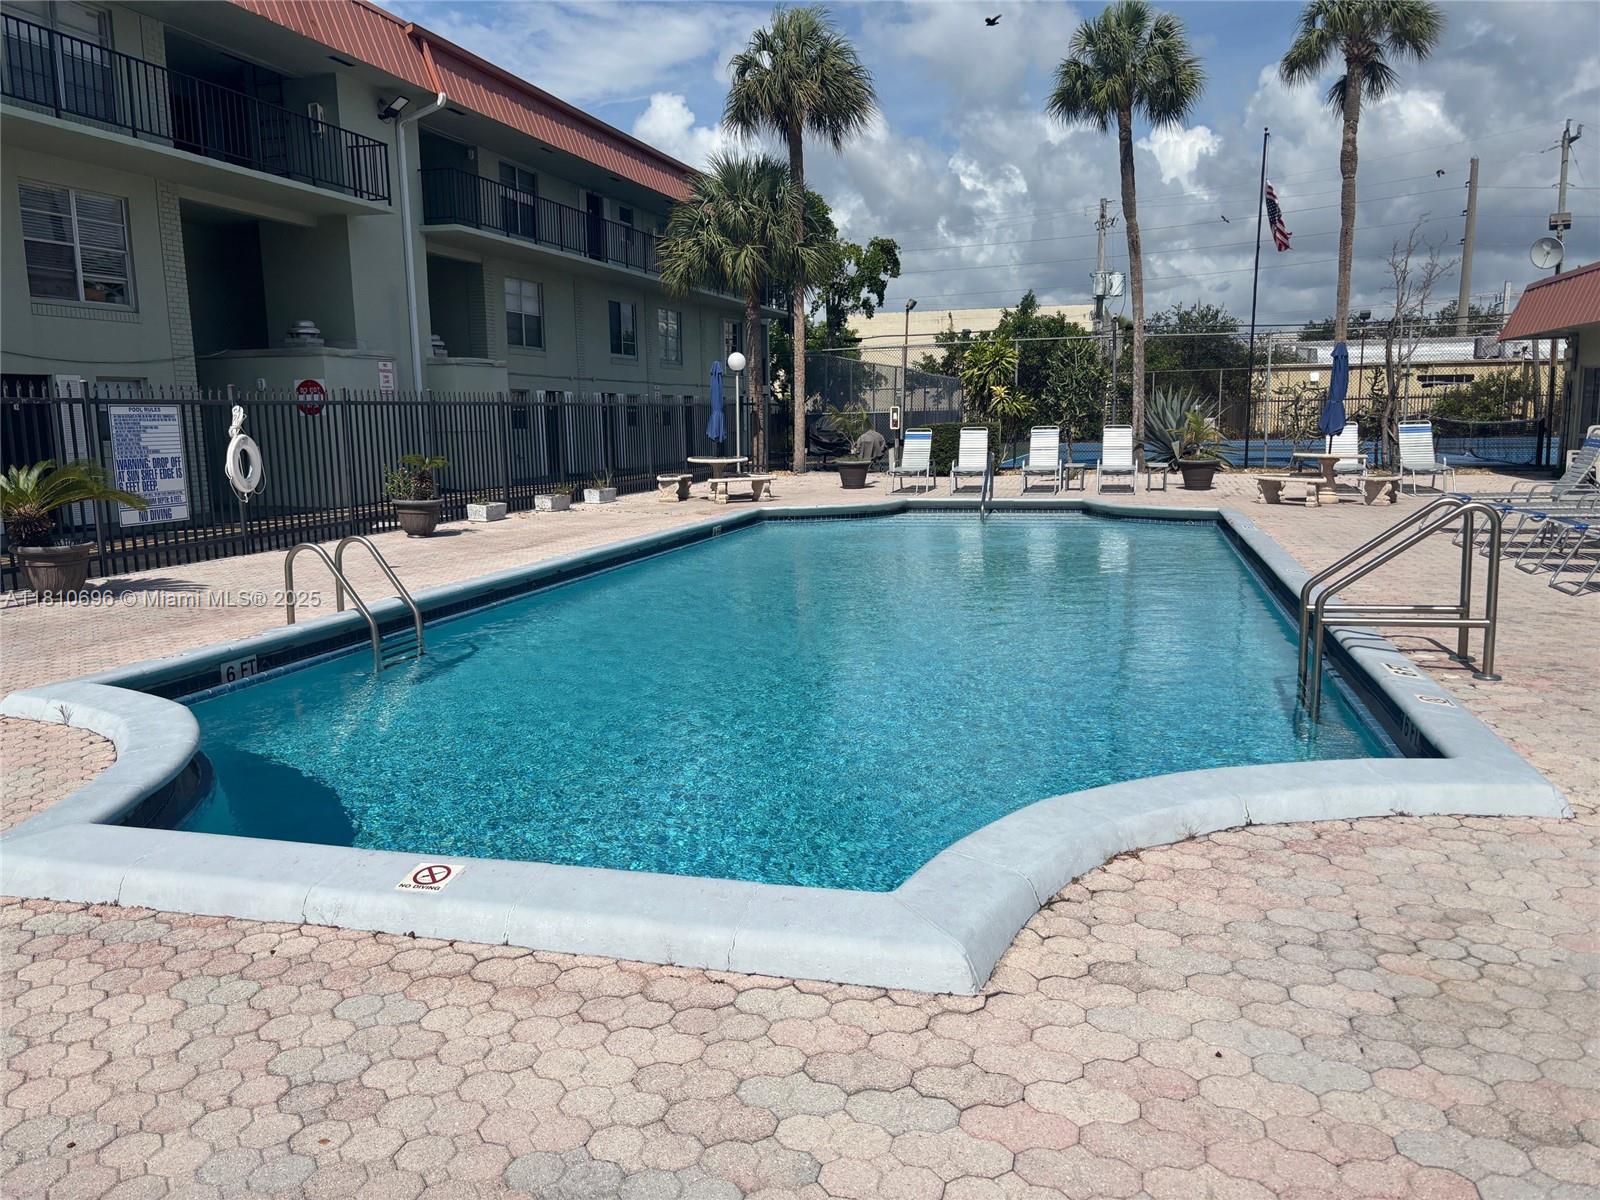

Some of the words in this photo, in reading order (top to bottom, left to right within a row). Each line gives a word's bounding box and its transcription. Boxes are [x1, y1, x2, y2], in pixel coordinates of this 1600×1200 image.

[116, 458, 151, 470] WARNING:
[152, 457, 169, 469] DROP
[170, 456, 181, 468] OFF
[117, 470, 125, 482] AT
[127, 470, 140, 481] SUN
[141, 469, 158, 480] SHELF
[160, 468, 175, 479] EDGE
[176, 468, 183, 479] IS
[125, 481, 140, 493] FEET
[139, 510, 149, 522] NO
[150, 508, 173, 520] DIVING
[227, 666, 236, 682] 6
